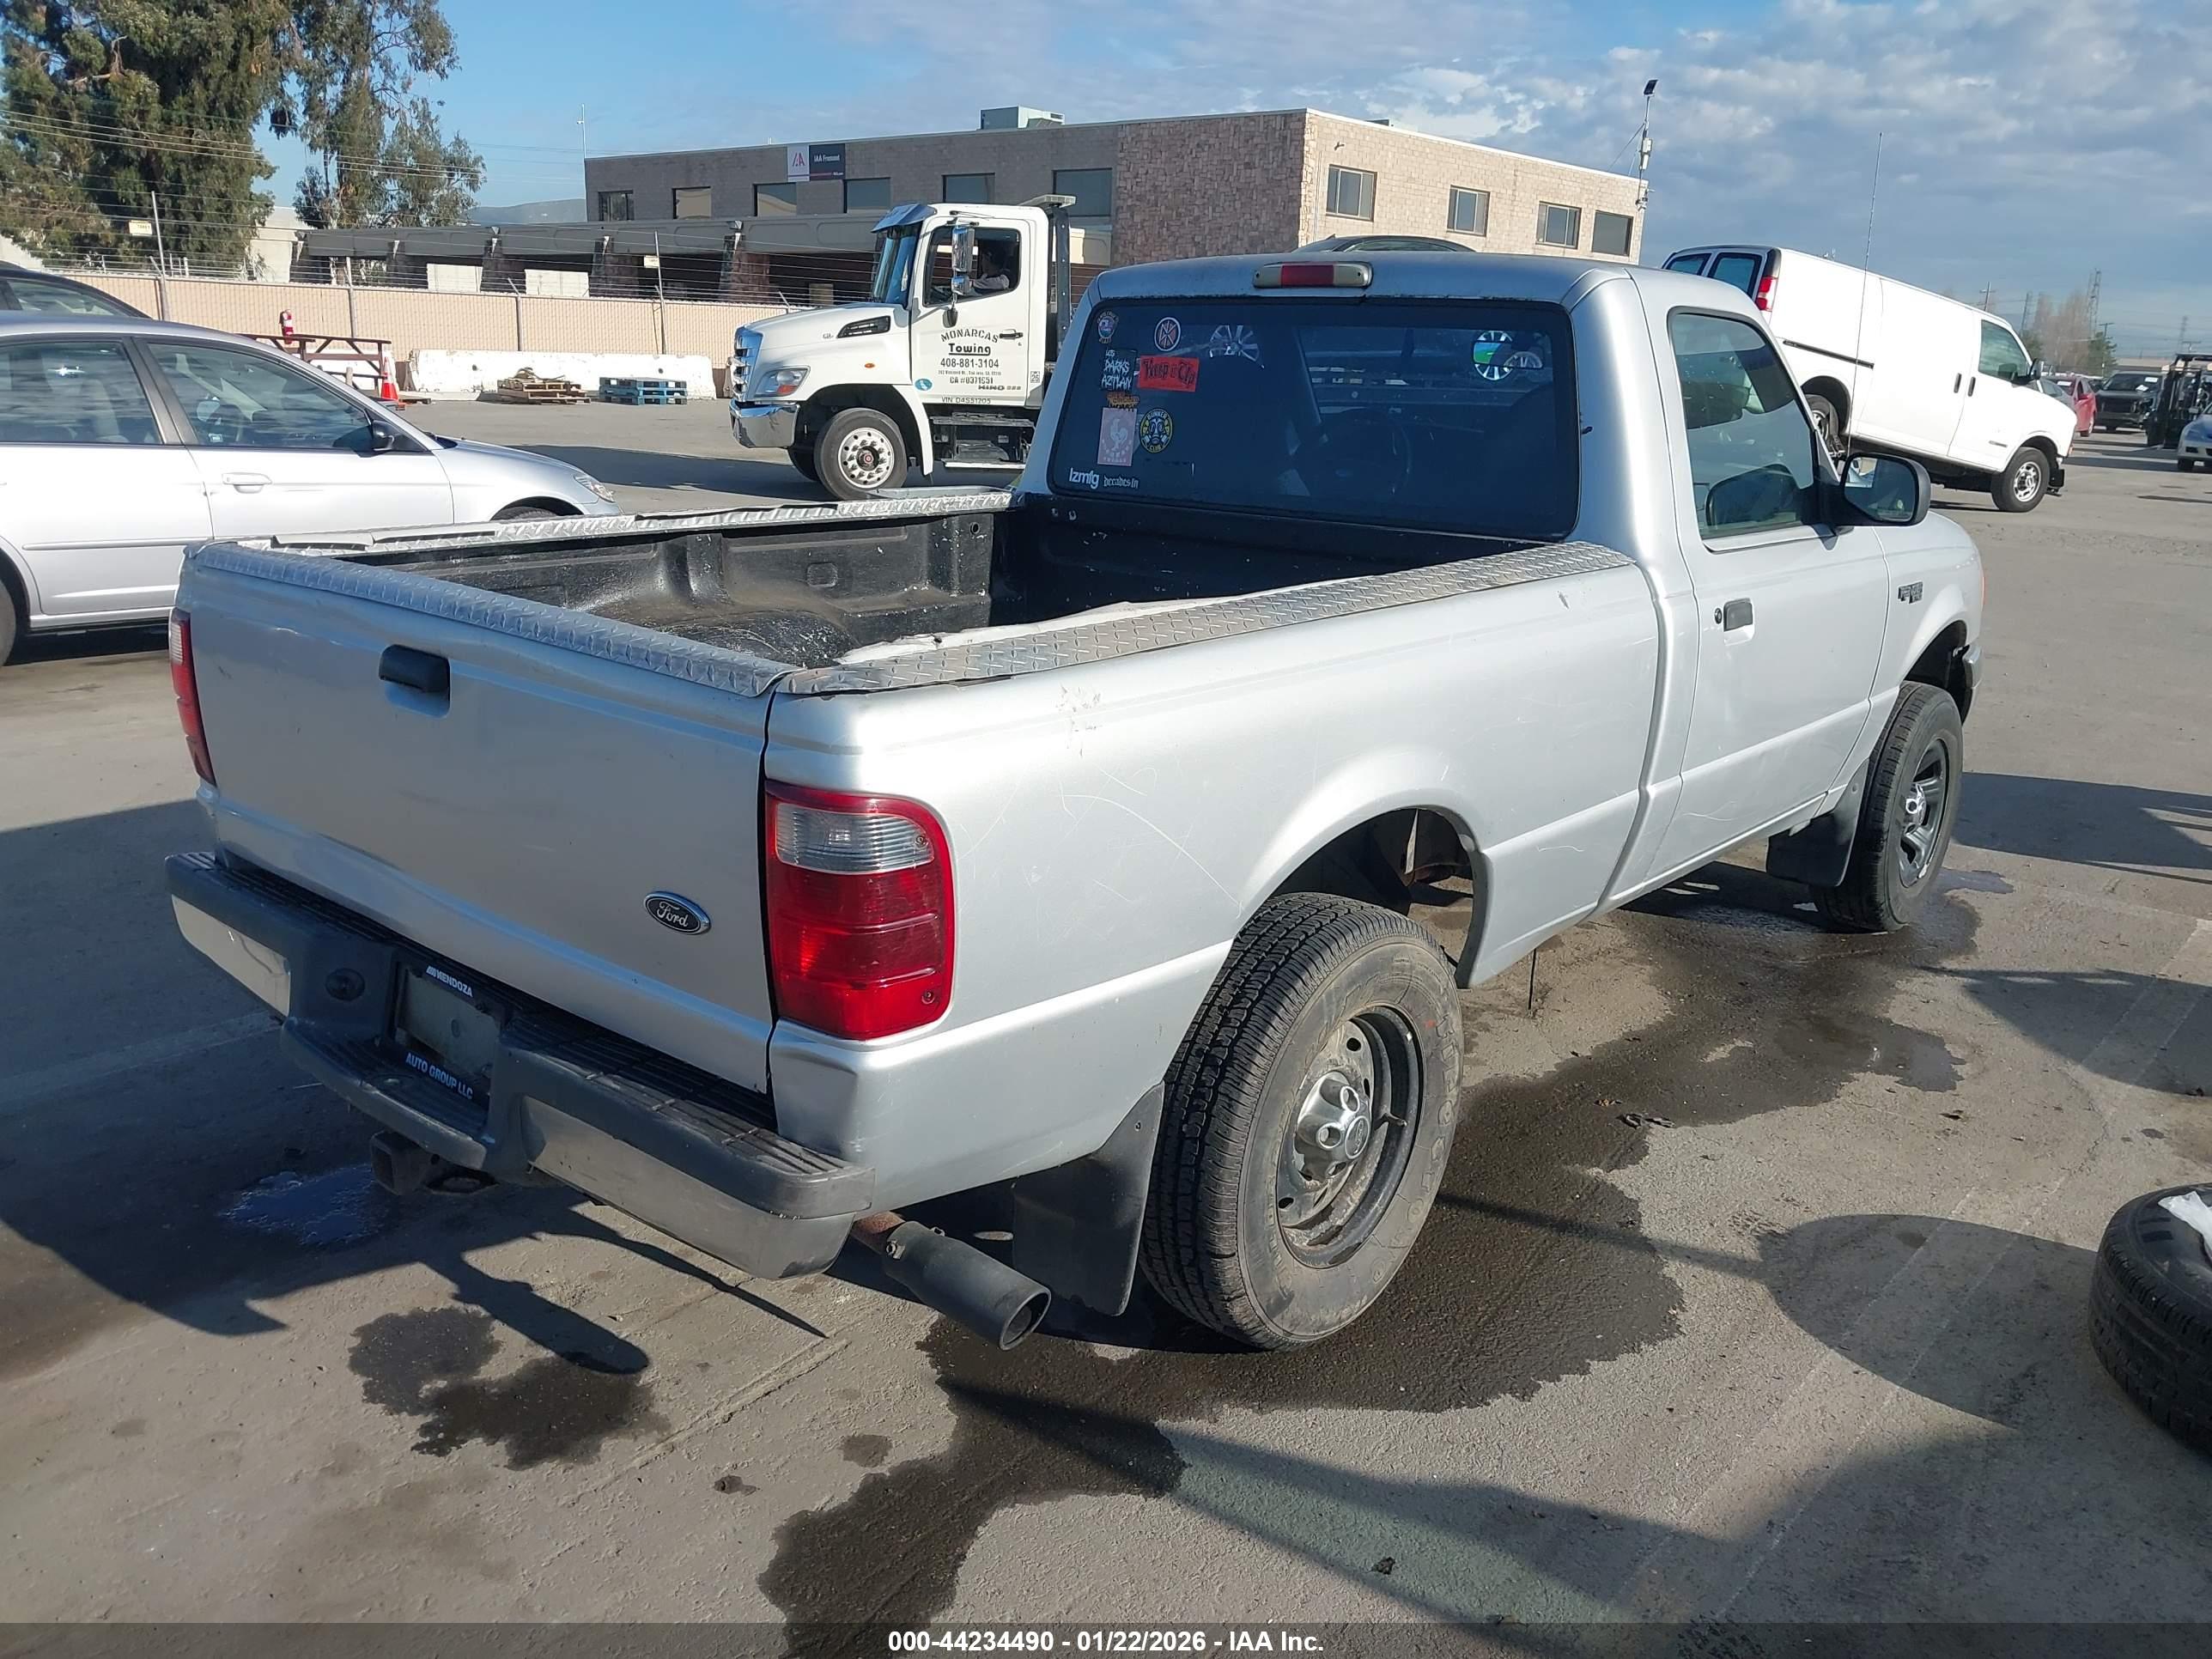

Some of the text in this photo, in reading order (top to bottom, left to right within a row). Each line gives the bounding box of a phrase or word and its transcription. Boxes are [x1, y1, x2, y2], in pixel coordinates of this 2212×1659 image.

[941, 328, 999, 343] MONARCAS
[948, 343, 991, 356] Towing
[940, 358, 1000, 368] 408-881-3104
[656, 901, 689, 927] Ford
[435, 969, 473, 998] MENDOZA
[405, 1052, 474, 1100] AUTO GROUP LLC
